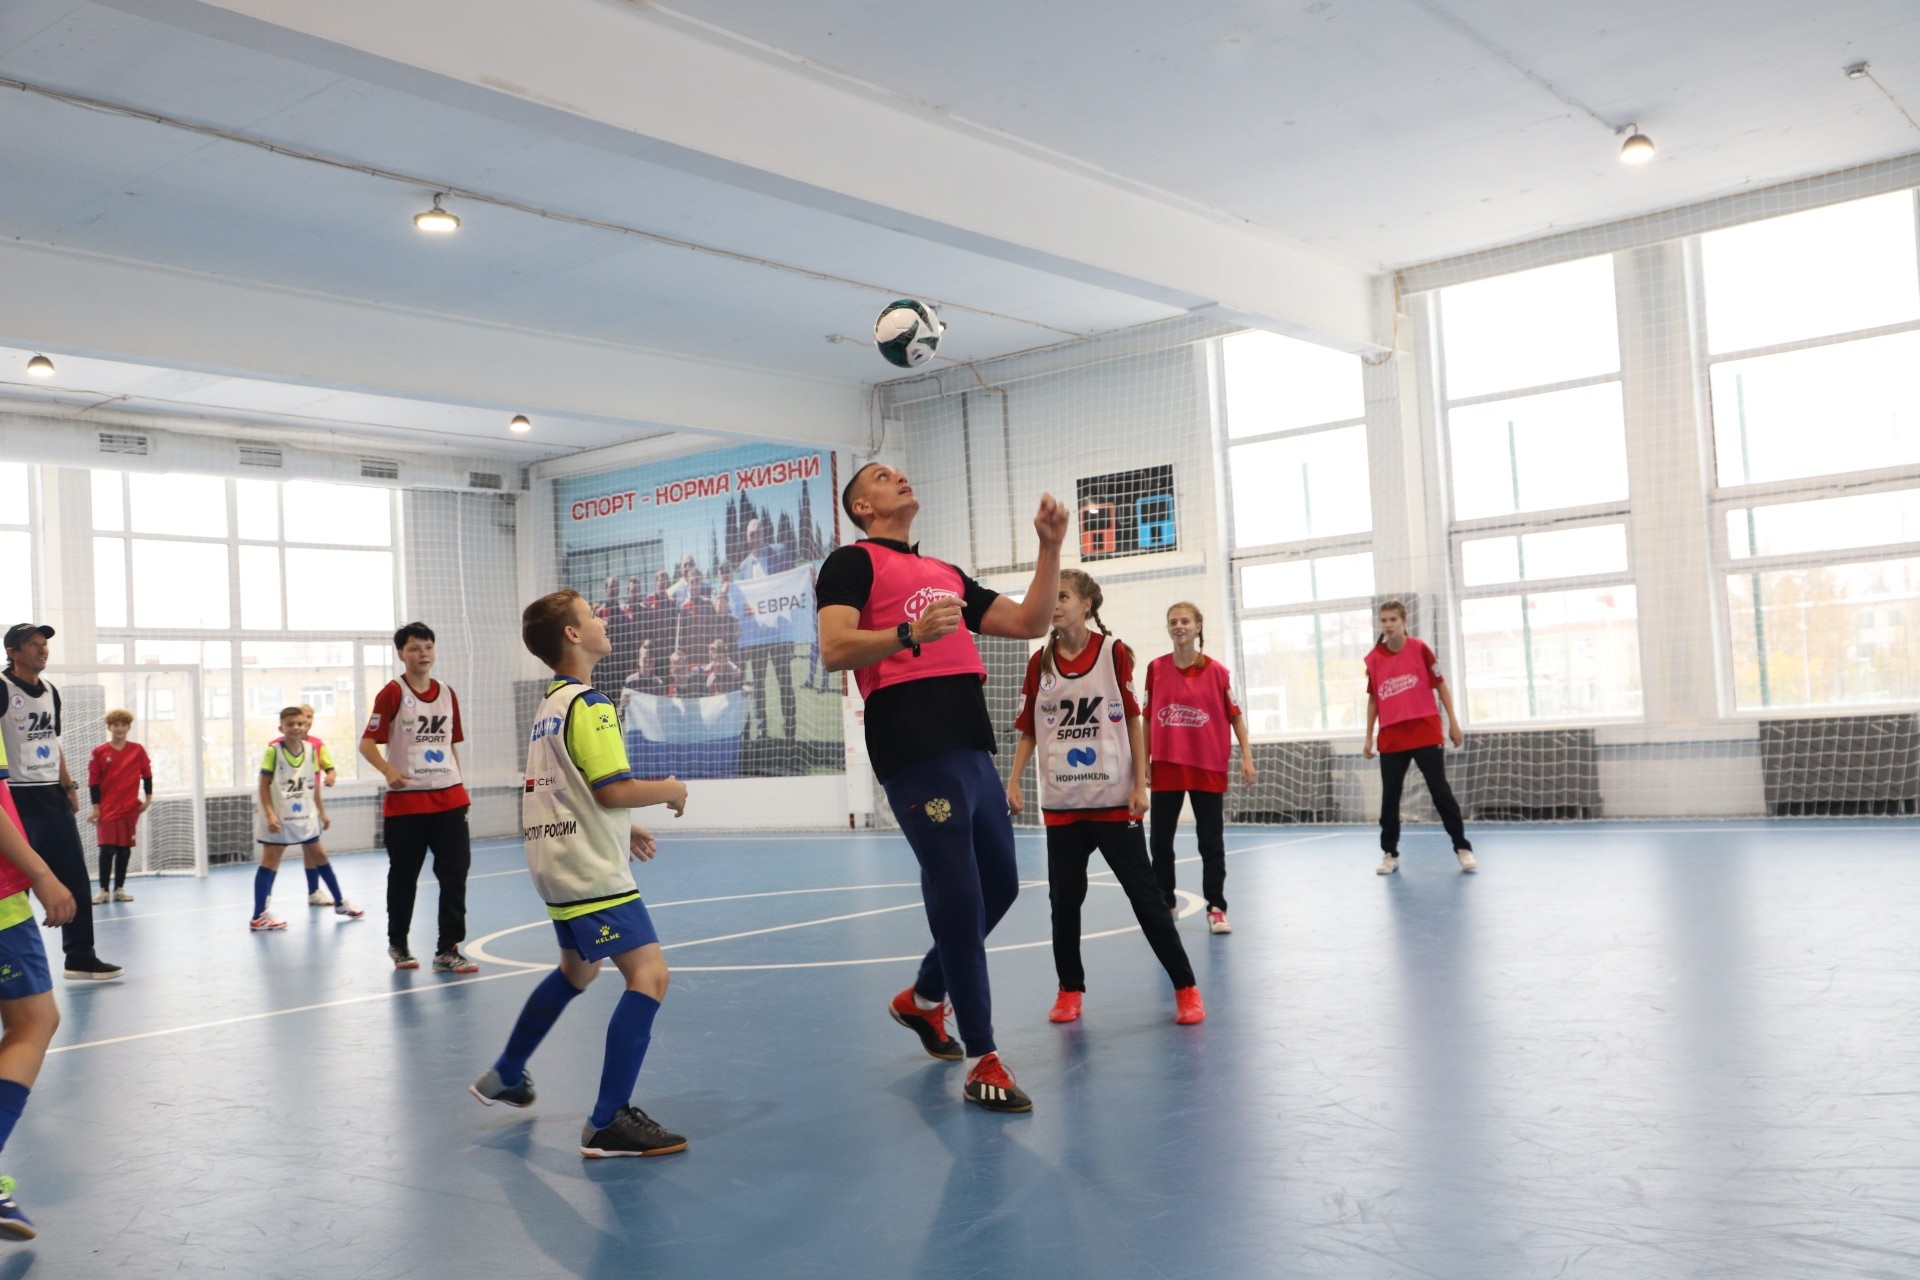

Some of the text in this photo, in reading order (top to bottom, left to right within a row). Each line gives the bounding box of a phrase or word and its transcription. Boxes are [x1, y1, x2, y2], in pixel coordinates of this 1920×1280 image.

[572, 492, 636, 520] СПОРТ
[655, 474, 730, 506] НОРМА
[737, 456, 821, 491] ЖИЗНИ
[906, 592, 957, 621] ФУТ
[1059, 696, 1104, 727] 2K
[417, 715, 448, 734] 2K
[1057, 726, 1100, 740] SPORT
[415, 735, 446, 743] SPORT
[1056, 772, 1110, 782] НОРНИКЕЛЬ
[544, 820, 577, 838] РОССИИ
[596, 933, 620, 944] KELME
